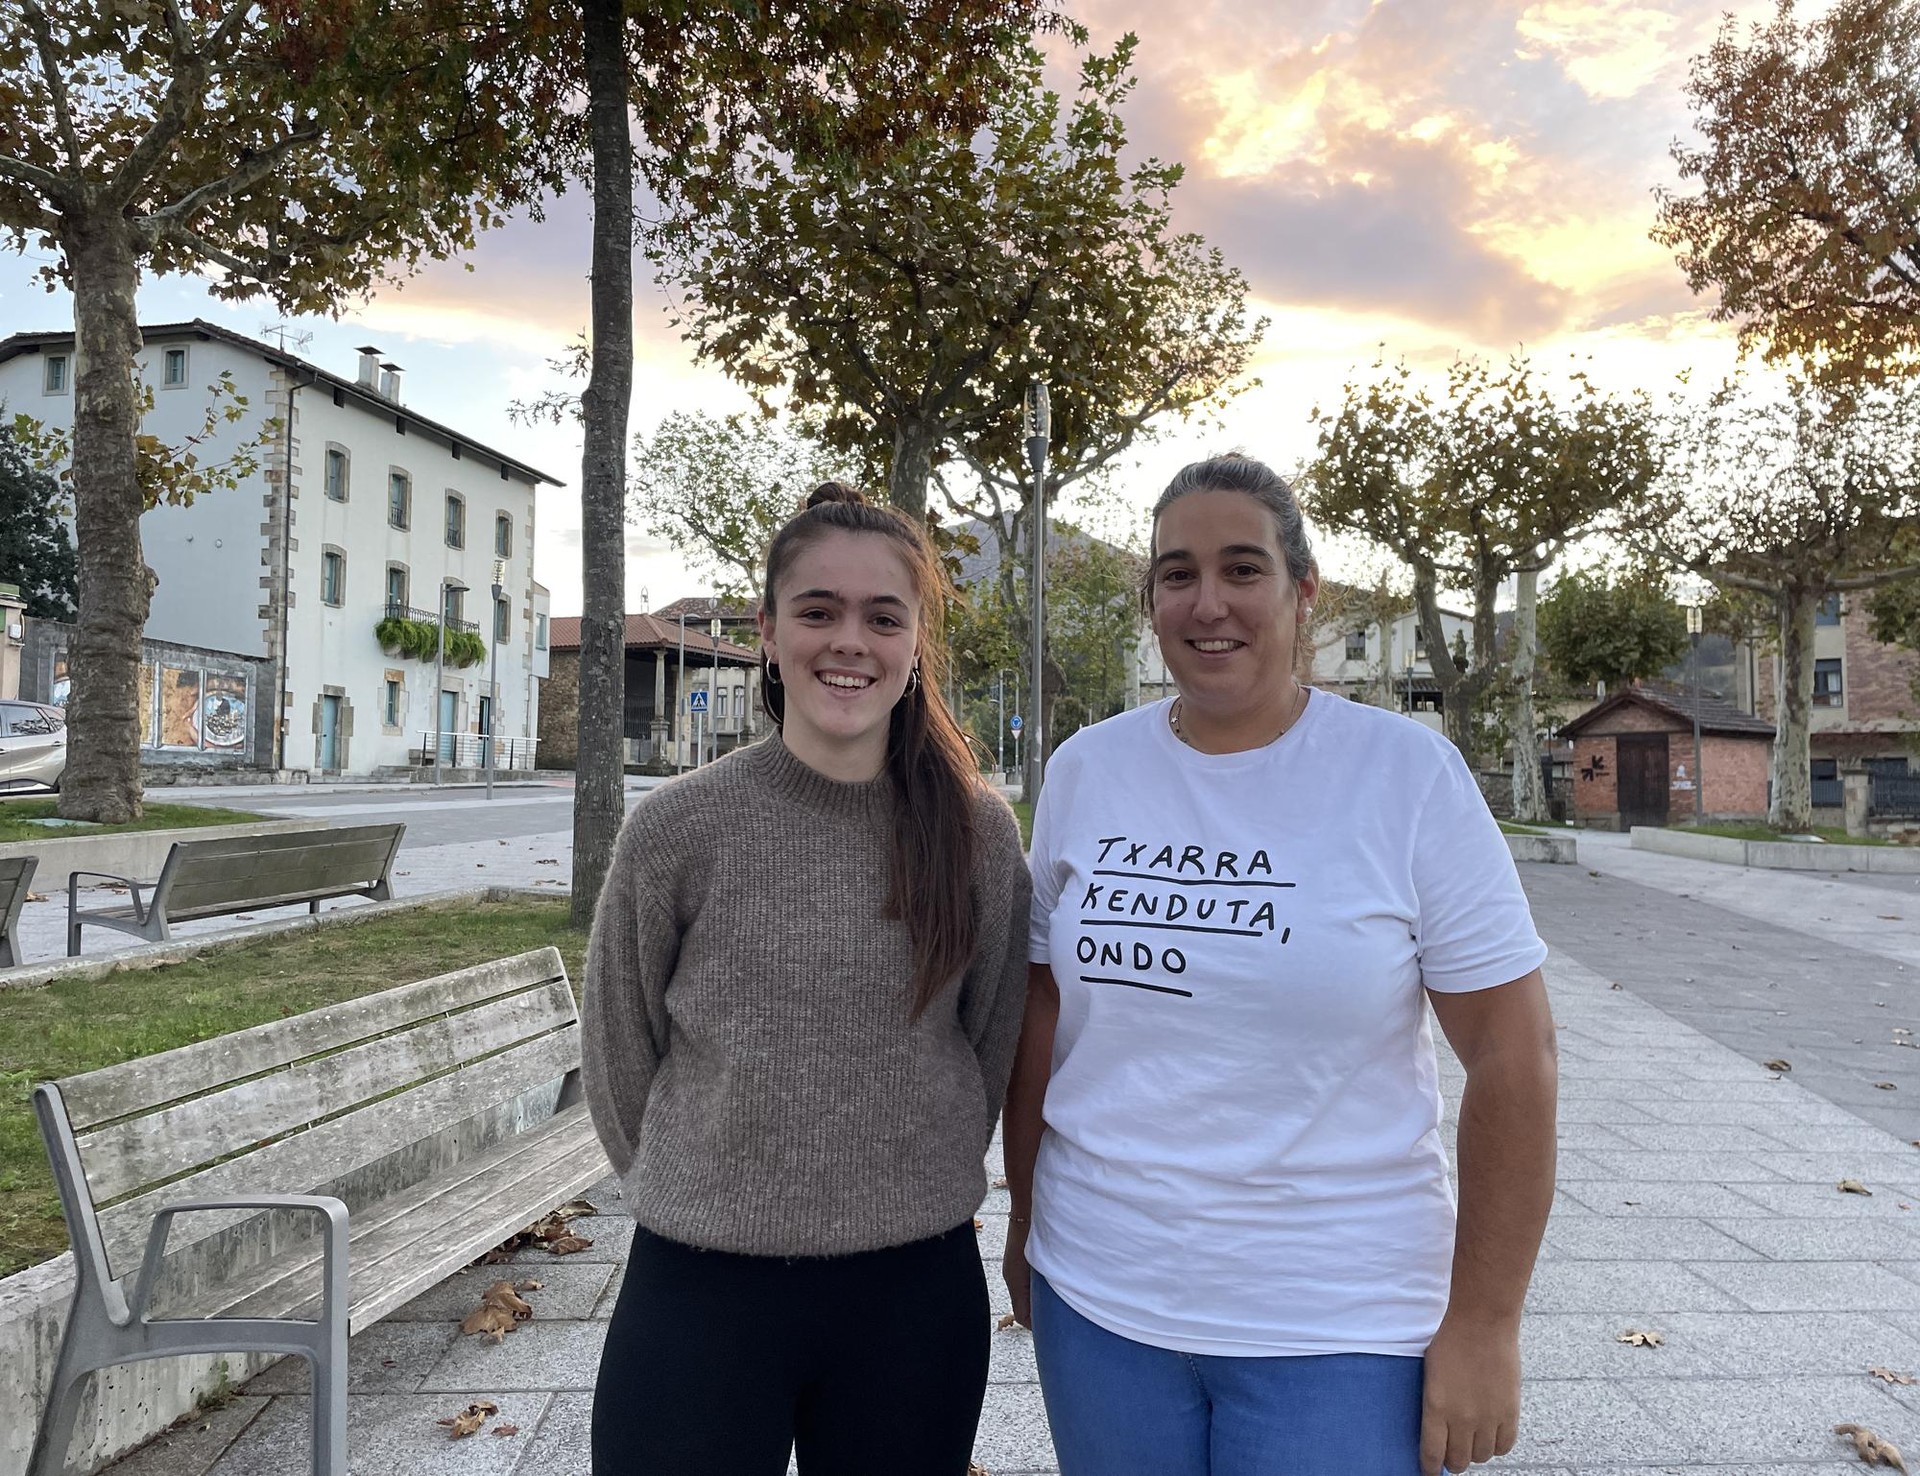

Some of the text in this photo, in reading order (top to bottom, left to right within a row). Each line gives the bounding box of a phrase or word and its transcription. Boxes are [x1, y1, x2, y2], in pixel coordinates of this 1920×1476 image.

[1097, 836, 1272, 878] TXARRA
[1080, 882, 1291, 945] KENDUTA,
[1076, 935, 1187, 974] ONDO
